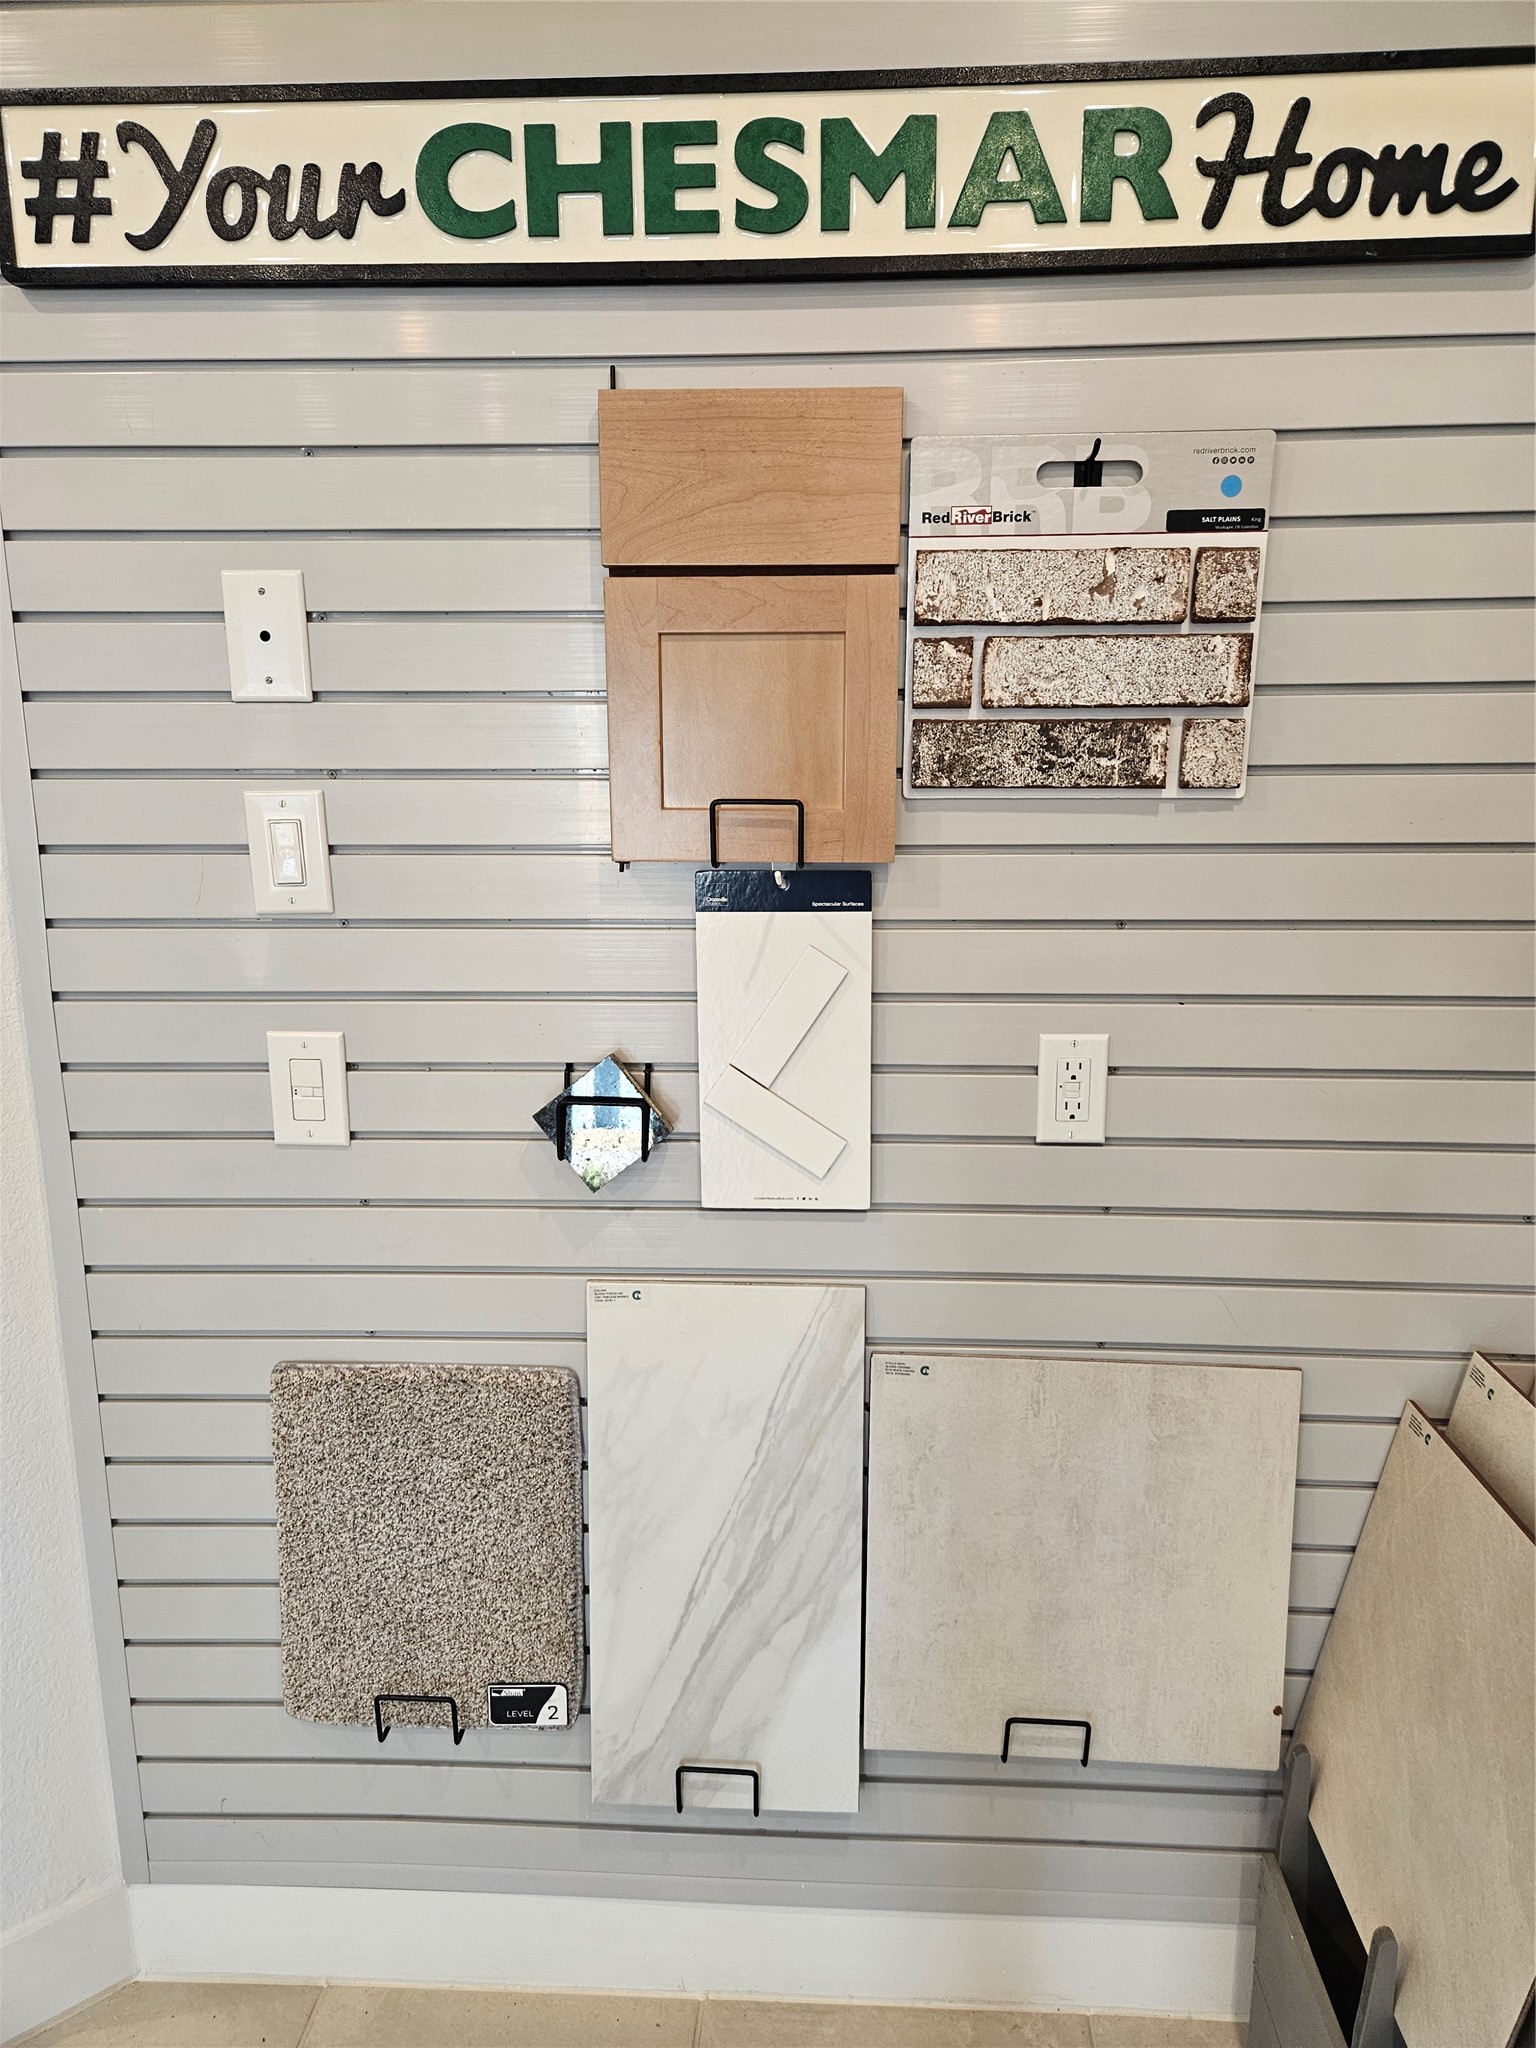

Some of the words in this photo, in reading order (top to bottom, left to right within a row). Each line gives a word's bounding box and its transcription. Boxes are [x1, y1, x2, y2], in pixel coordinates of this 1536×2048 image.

[20, 117, 406, 251] #Your
[415, 106, 1180, 240] CHESMAR
[1195, 91, 1520, 230] Home
[1192, 447, 1257, 455] redriverbrick.com
[506, 1710, 534, 1718] LEVEL
[547, 1705, 559, 1720] 2
